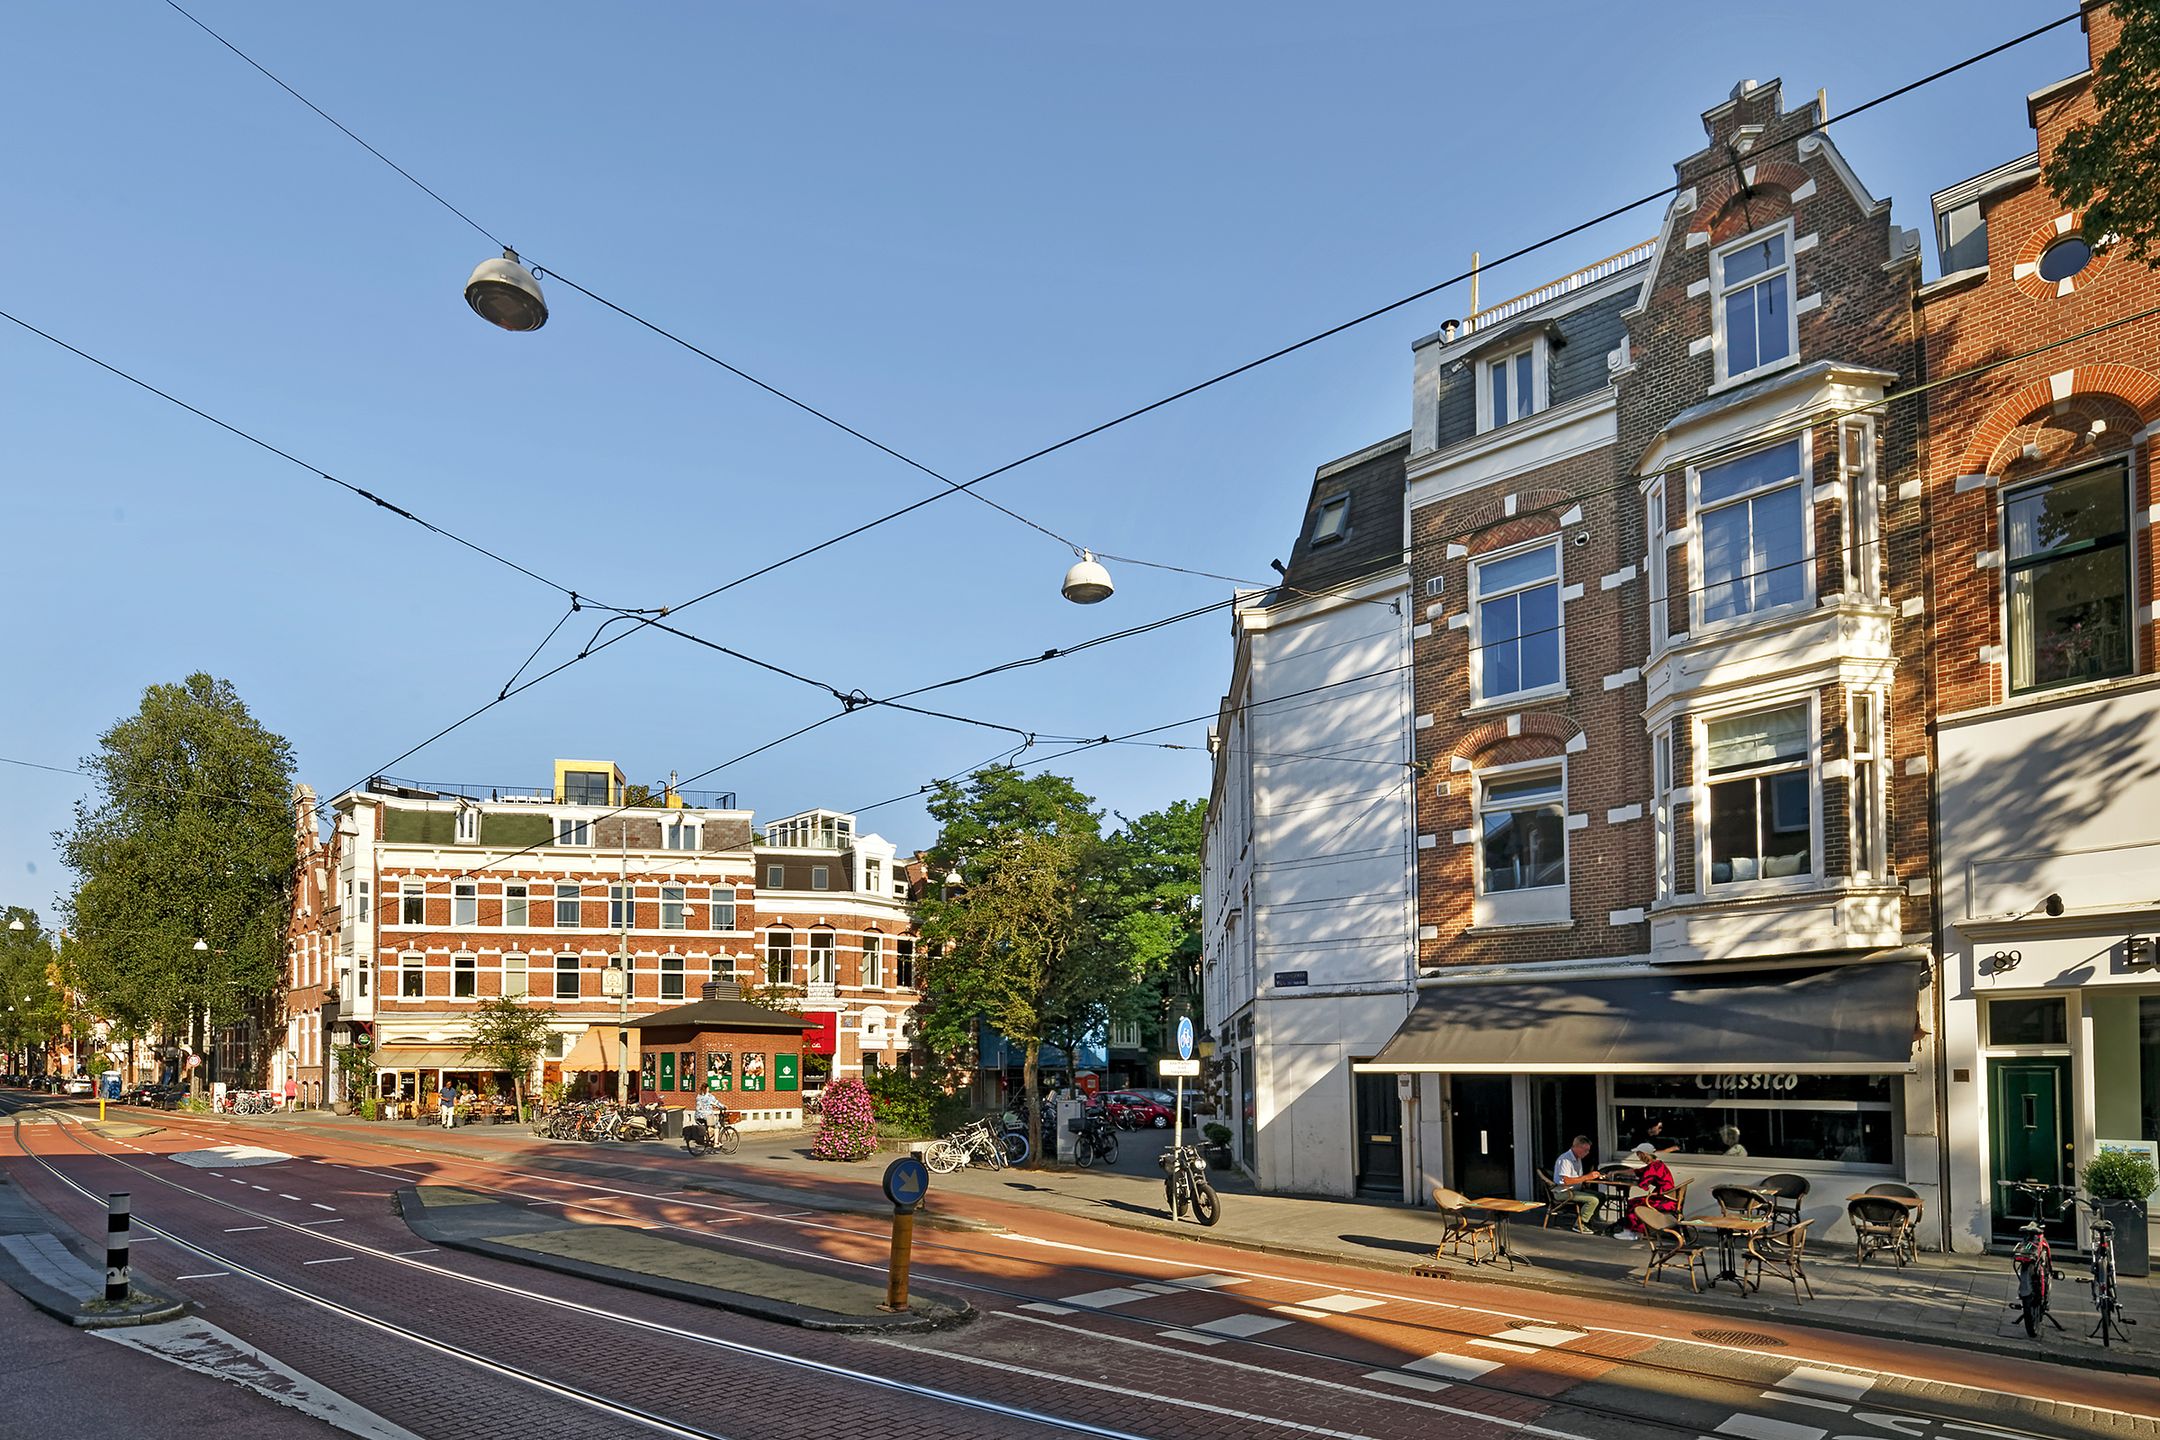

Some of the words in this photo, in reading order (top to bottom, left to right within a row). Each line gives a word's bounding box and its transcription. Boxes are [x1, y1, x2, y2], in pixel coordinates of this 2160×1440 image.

[1994, 950, 2022, 976] 89
[2128, 936, 2160, 966] E
[1695, 1074, 1798, 1090] Classico
